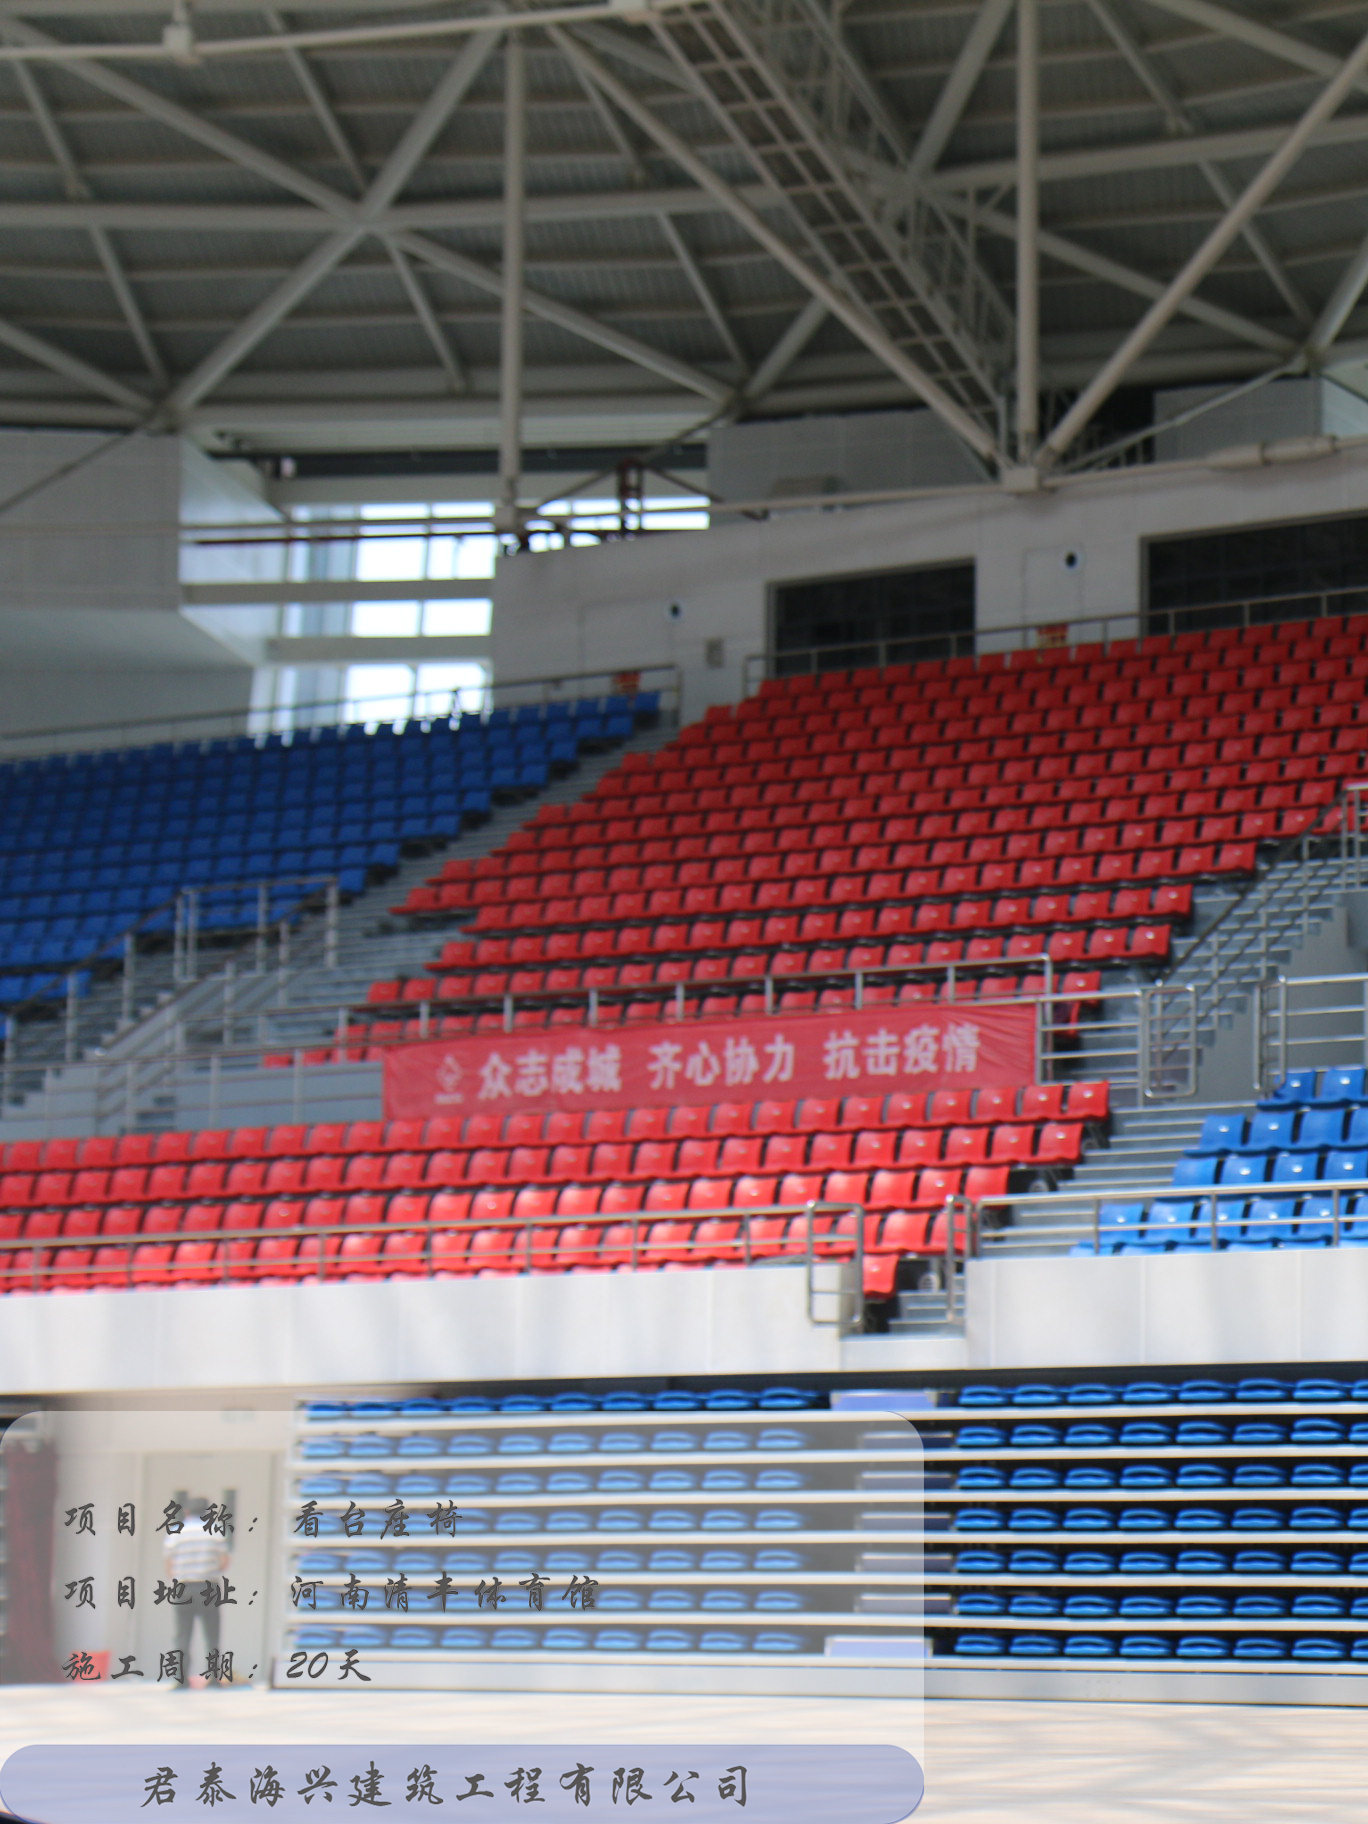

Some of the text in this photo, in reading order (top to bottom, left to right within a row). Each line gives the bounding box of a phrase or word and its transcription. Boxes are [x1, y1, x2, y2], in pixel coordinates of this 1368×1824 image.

[477, 1022, 981, 1099] 众志成城 齐心协力 抗击疫情
